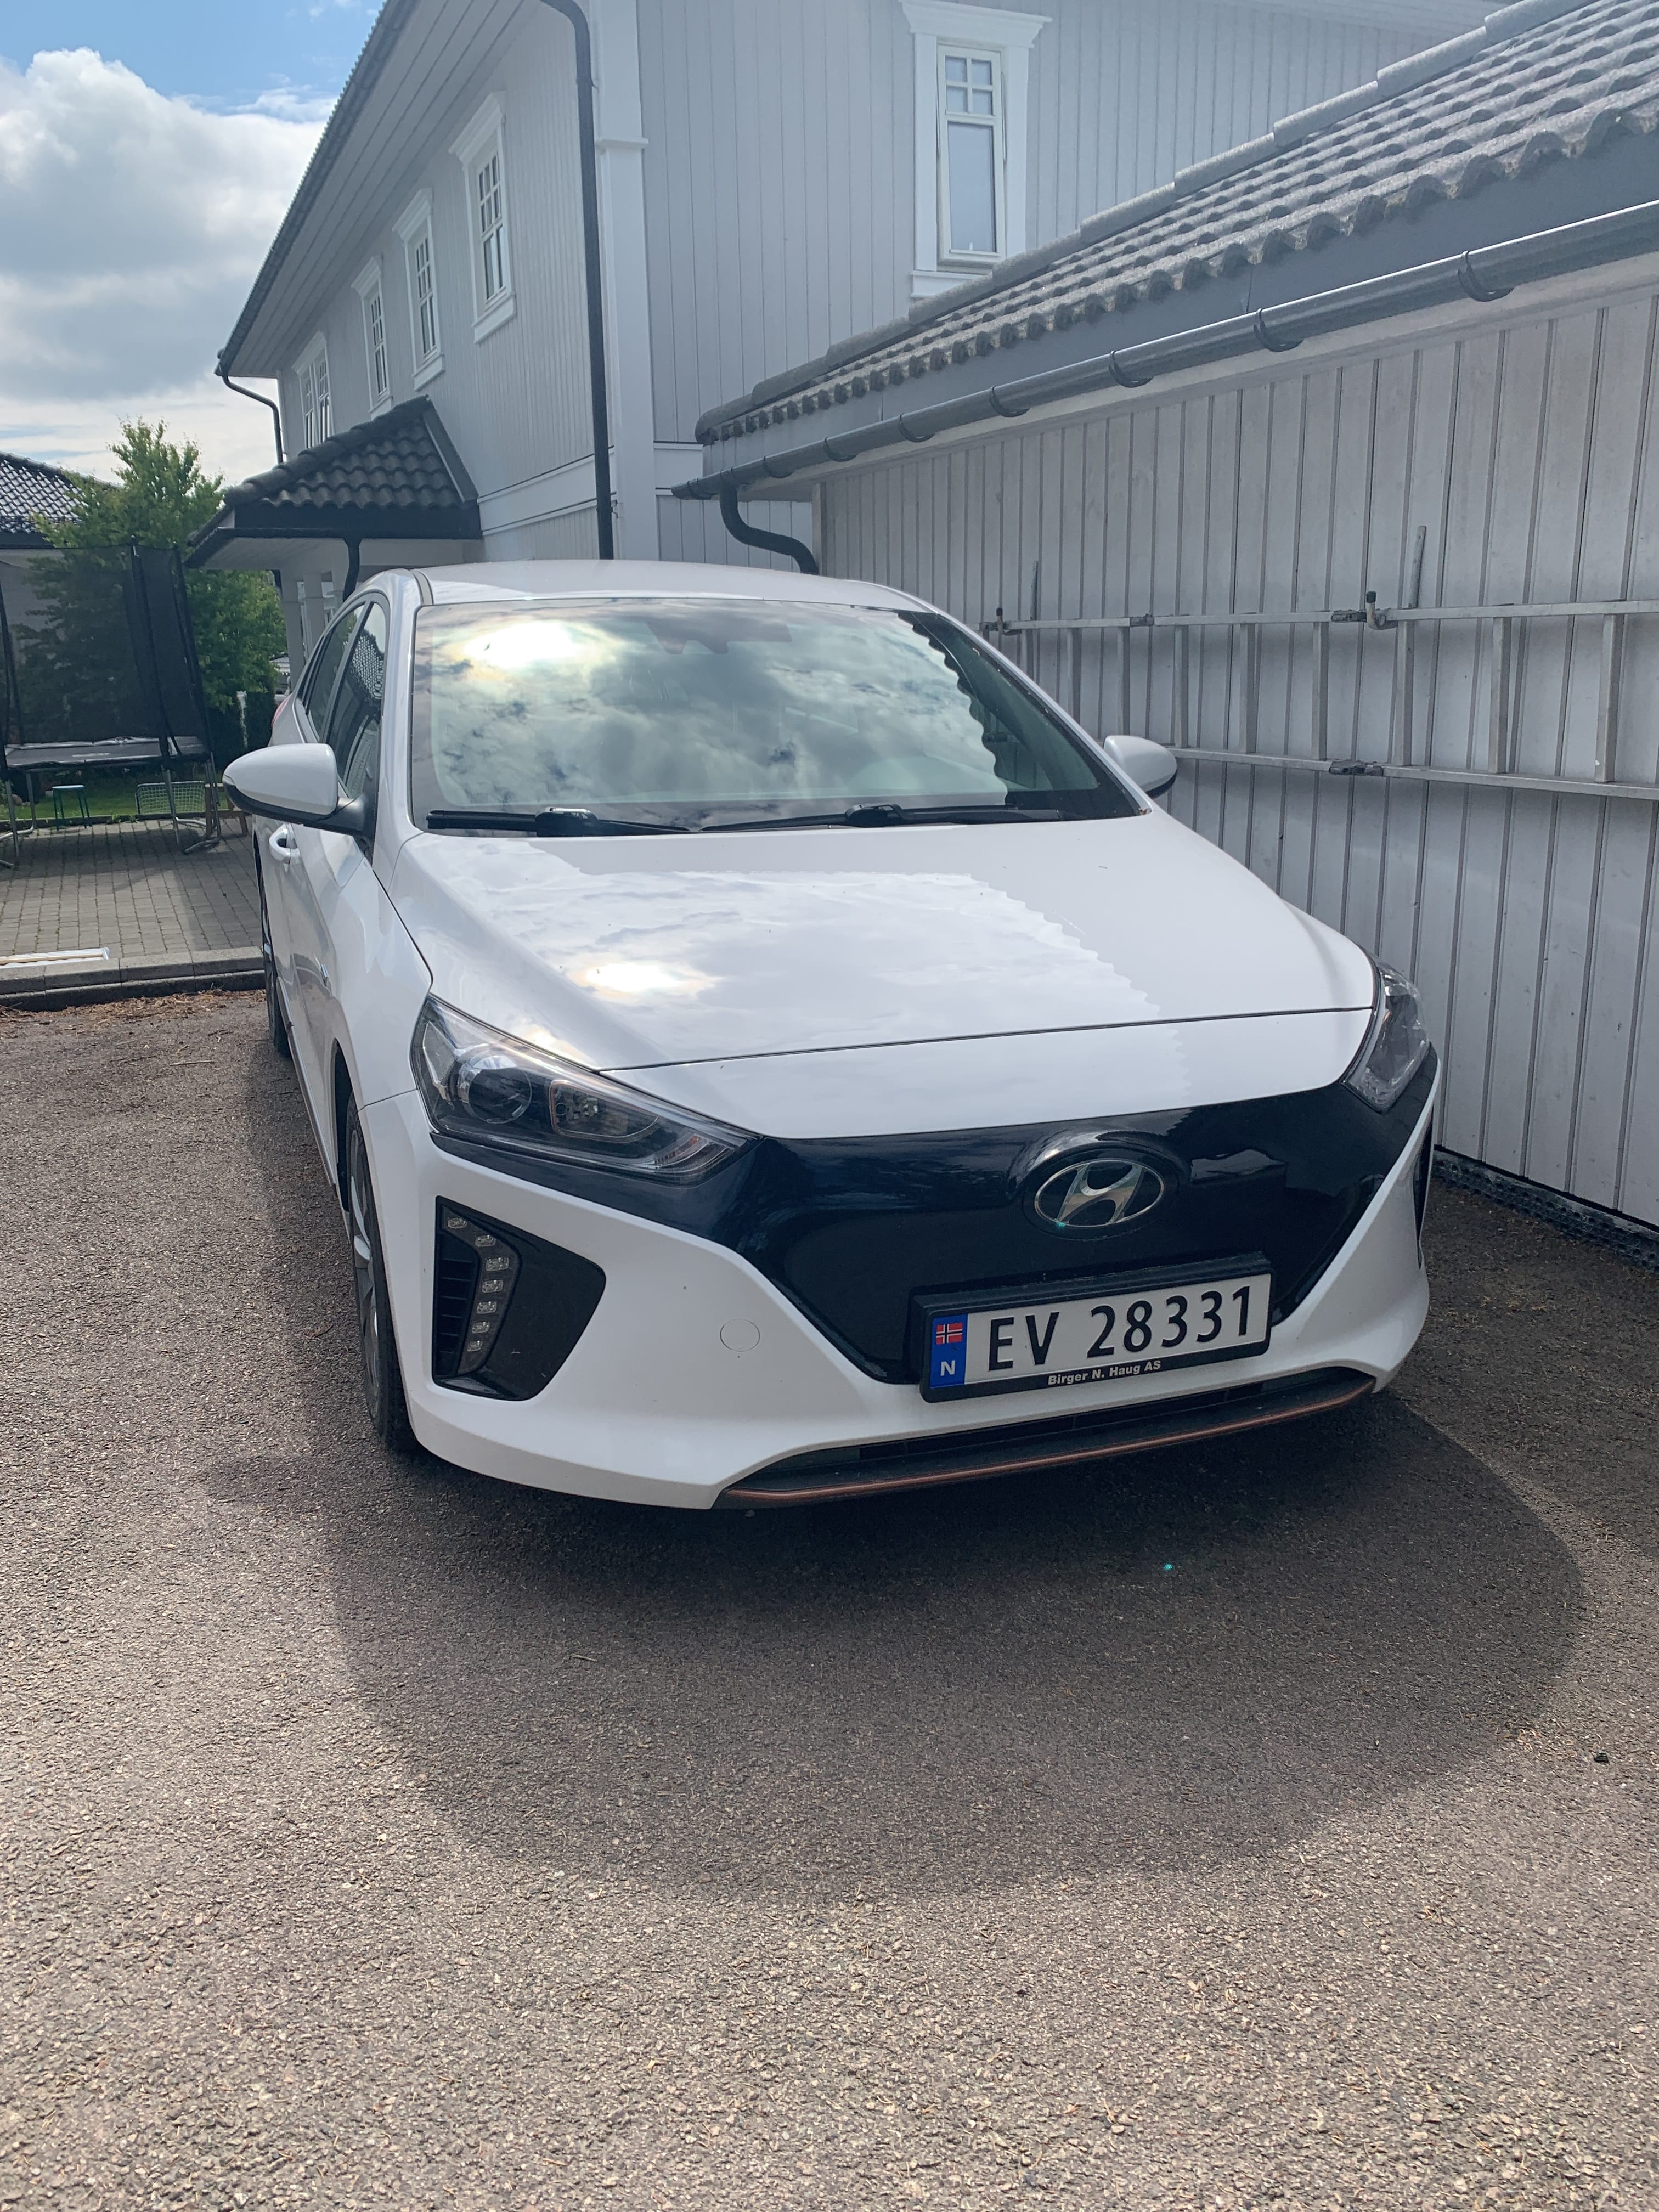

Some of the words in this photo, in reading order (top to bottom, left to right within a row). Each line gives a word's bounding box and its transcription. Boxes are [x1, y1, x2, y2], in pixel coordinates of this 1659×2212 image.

[988, 1311, 1060, 1371] EV
[1086, 1285, 1251, 1358] 28331
[940, 1360, 956, 1377] N
[1047, 1373, 1088, 1385] Birger
[1092, 1369, 1104, 1379] N.
[1109, 1363, 1140, 1378] Haug
[1144, 1360, 1161, 1371] AS
